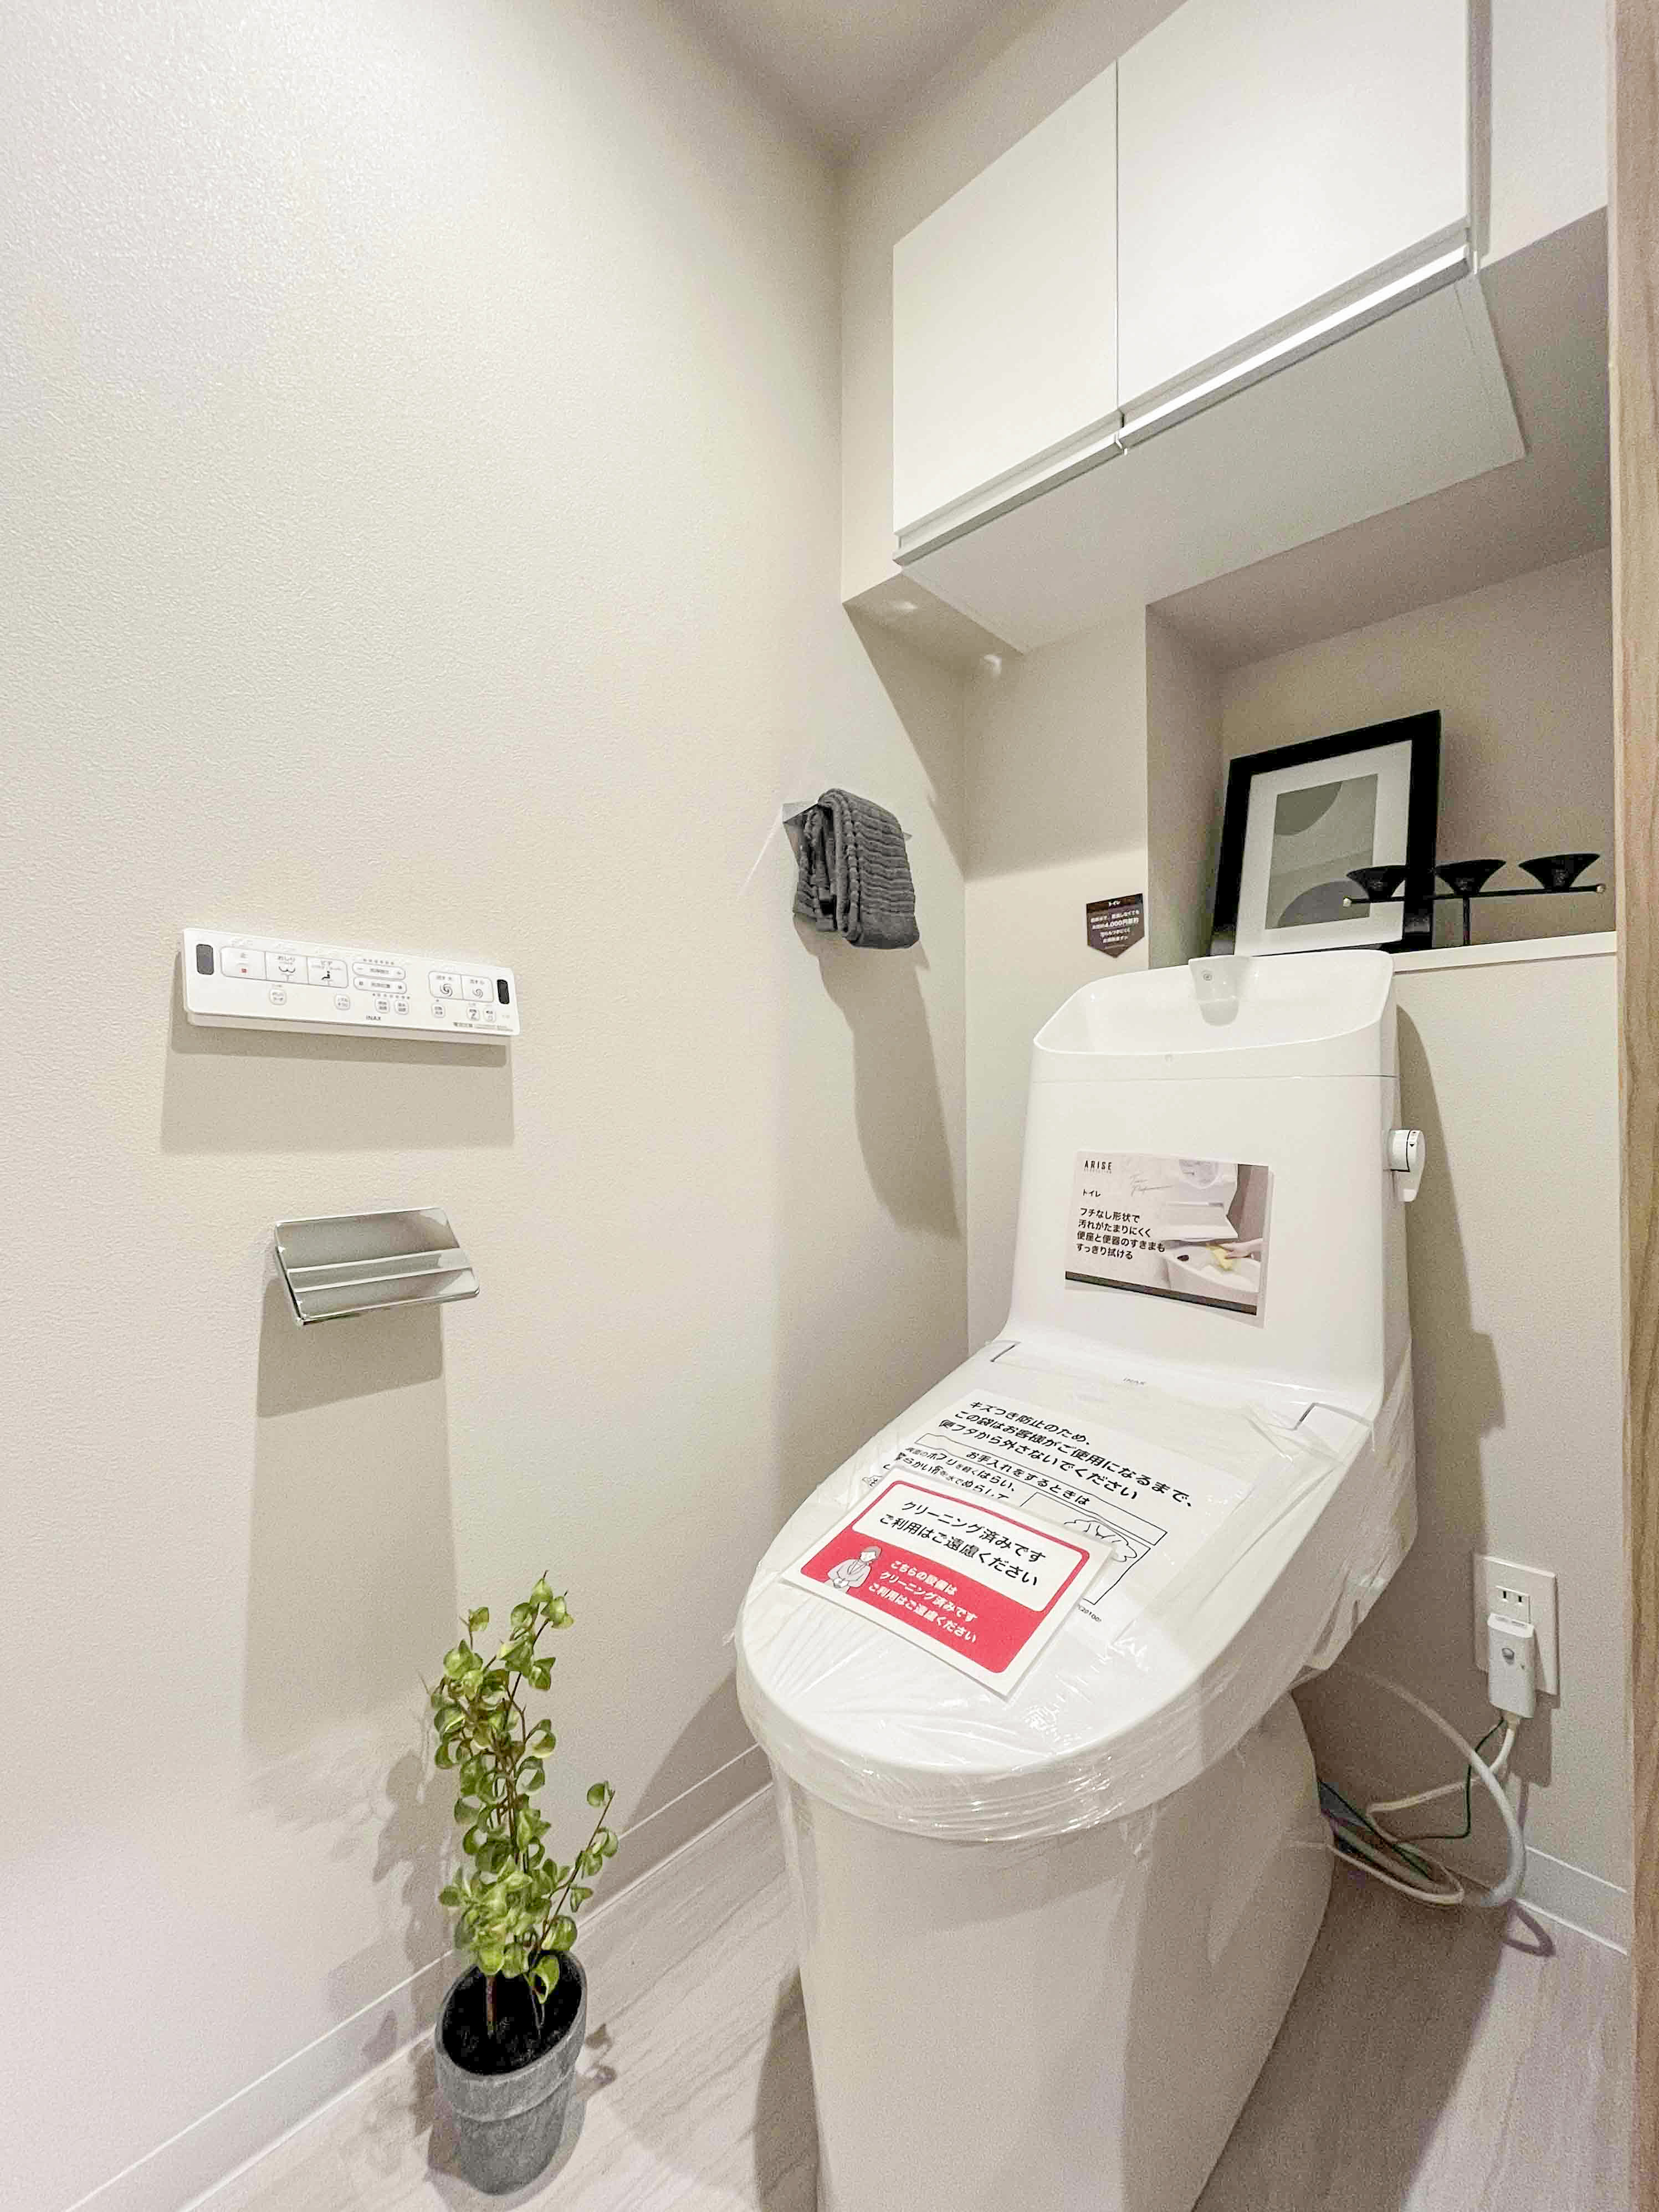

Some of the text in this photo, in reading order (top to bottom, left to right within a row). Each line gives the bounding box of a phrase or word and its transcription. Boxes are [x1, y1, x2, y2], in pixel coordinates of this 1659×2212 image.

[1084, 1160, 1112, 1170] ARISE
[1082, 1189, 1102, 1197] トイレ
[1081, 1207, 1140, 1223] フチなし形状で
[1078, 1219, 1151, 1237] 汚れがたまりにくく
[1077, 1231, 1165, 1252] 便座と便器のすきまも
[1077, 1243, 1133, 1259] すっきり拭ける
[966, 1451, 1090, 1506] お手入れをするときは
[902, 1501, 1046, 1562] クリーニング済みです
[879, 1513, 1037, 1586] ご利用はご遠慮ください
[879, 1571, 978, 1622] クリーニング済みです
[868, 1582, 976, 1643] ご利用はご遠慮ください
